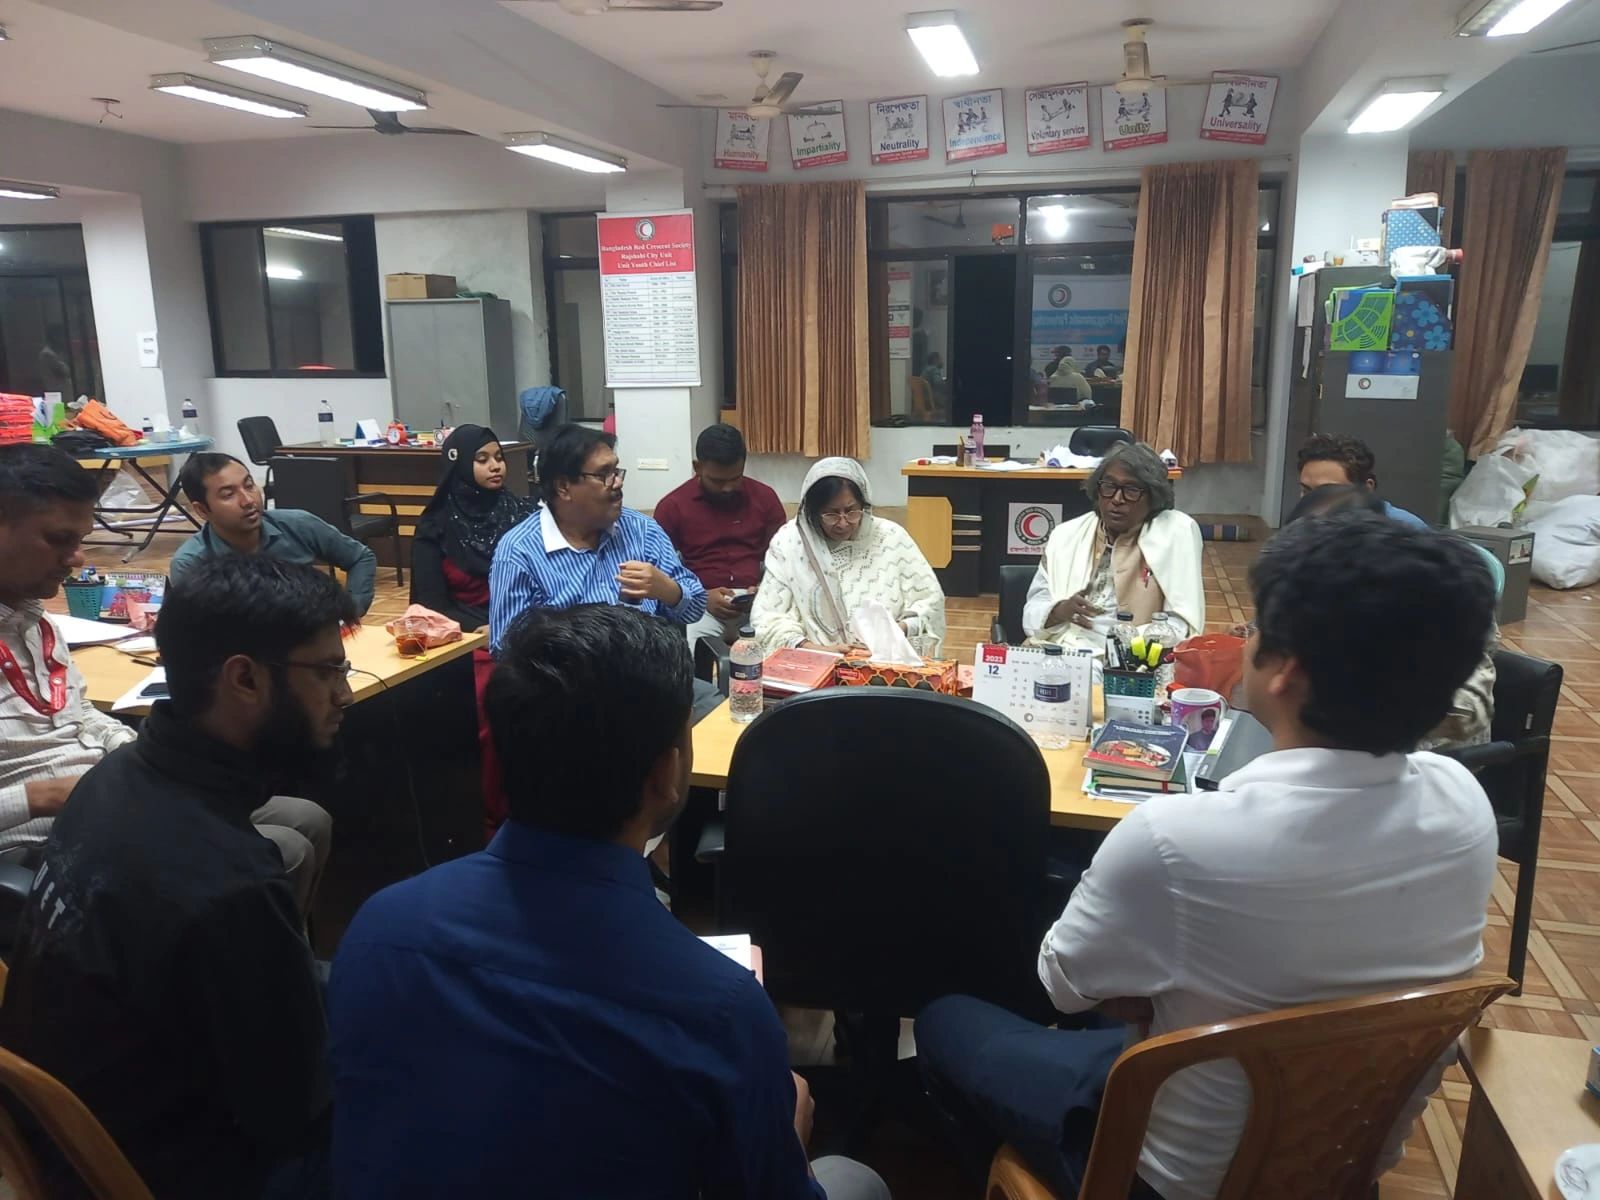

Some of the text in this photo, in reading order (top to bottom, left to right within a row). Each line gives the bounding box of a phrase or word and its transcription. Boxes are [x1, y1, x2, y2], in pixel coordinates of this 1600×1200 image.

[1210, 117, 1262, 132] Universality
[1062, 125, 1086, 135] service
[796, 140, 842, 157] Impartiality
[880, 139, 920, 152] Neutrality
[723, 149, 760, 160] Humanity
[601, 244, 633, 252] Bangladesh
[646, 242, 671, 250] Crescent
[646, 251, 659, 259] City
[988, 665, 1000, 675] 12
